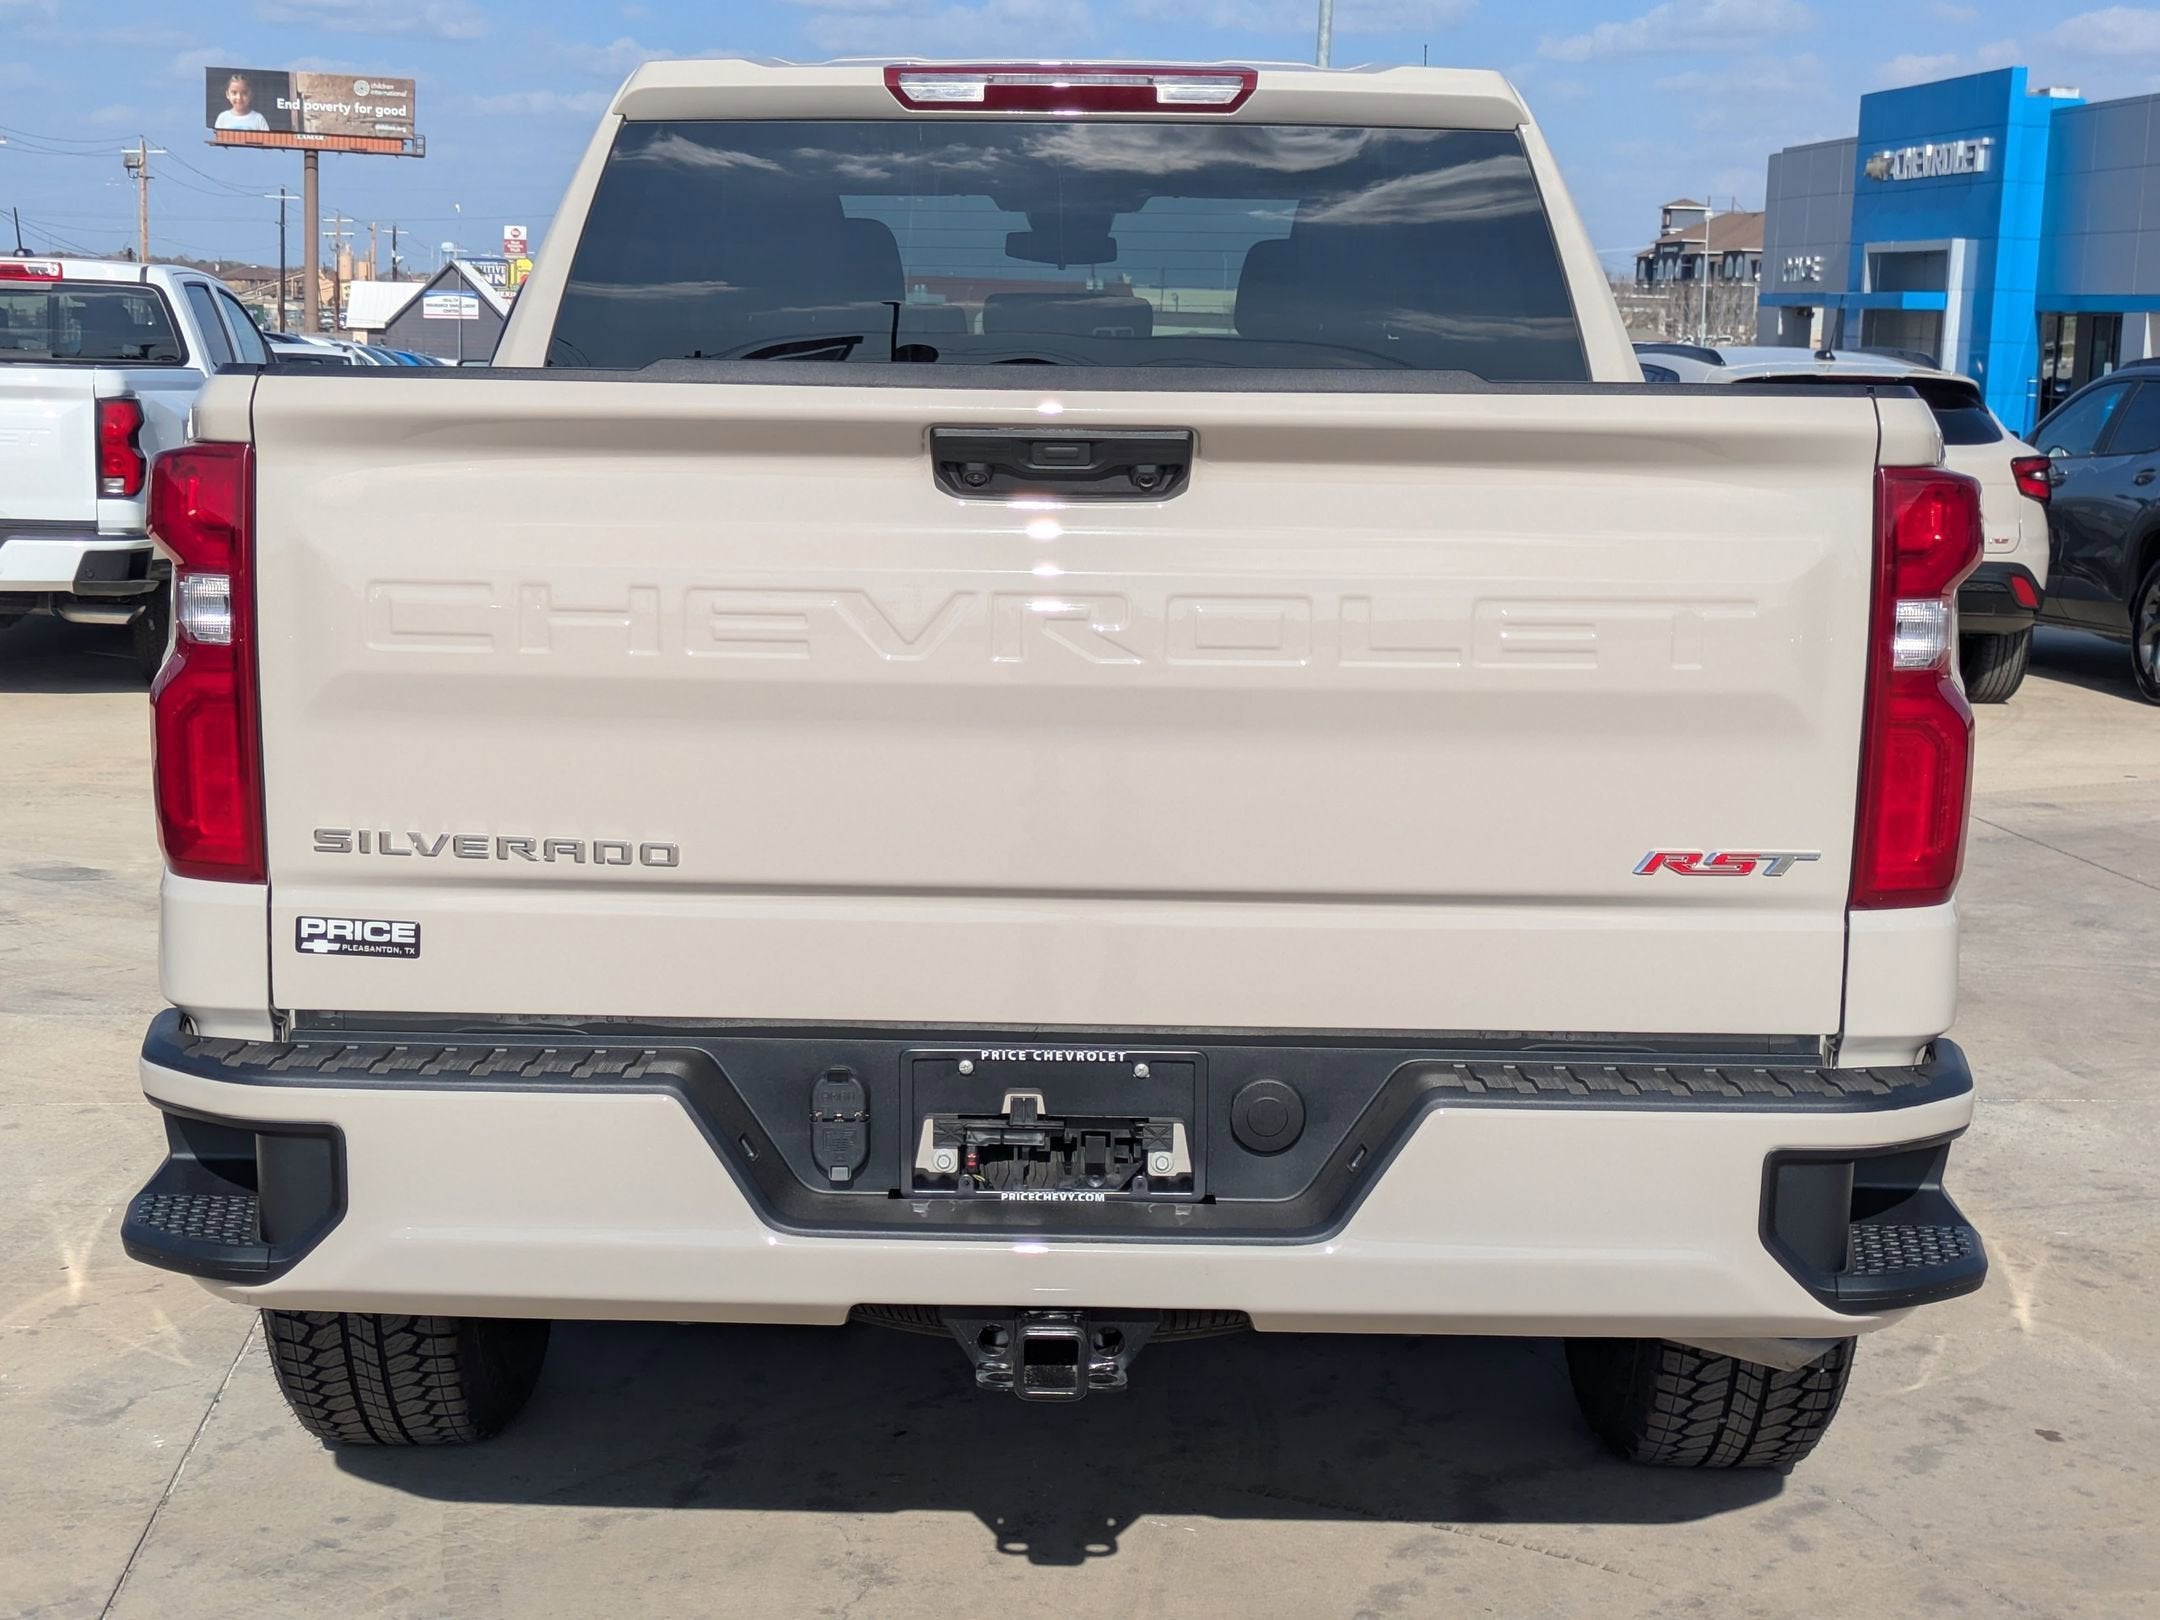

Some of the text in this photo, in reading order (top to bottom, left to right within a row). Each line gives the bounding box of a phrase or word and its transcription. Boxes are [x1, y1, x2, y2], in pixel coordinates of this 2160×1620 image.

[276, 98, 407, 117] End poverty for good
[1892, 136, 1995, 181] CHEVROLET
[365, 580, 1758, 671] CHEVROLET
[313, 828, 680, 868] SILVERADO
[1632, 848, 1821, 876] RST
[300, 917, 416, 944] PRICE
[342, 944, 416, 955] PLEASANTON, TX
[981, 1050, 1127, 1062] PRICE CHEVROLET
[1001, 1191, 1105, 1202] PRICECHEVY.COM
